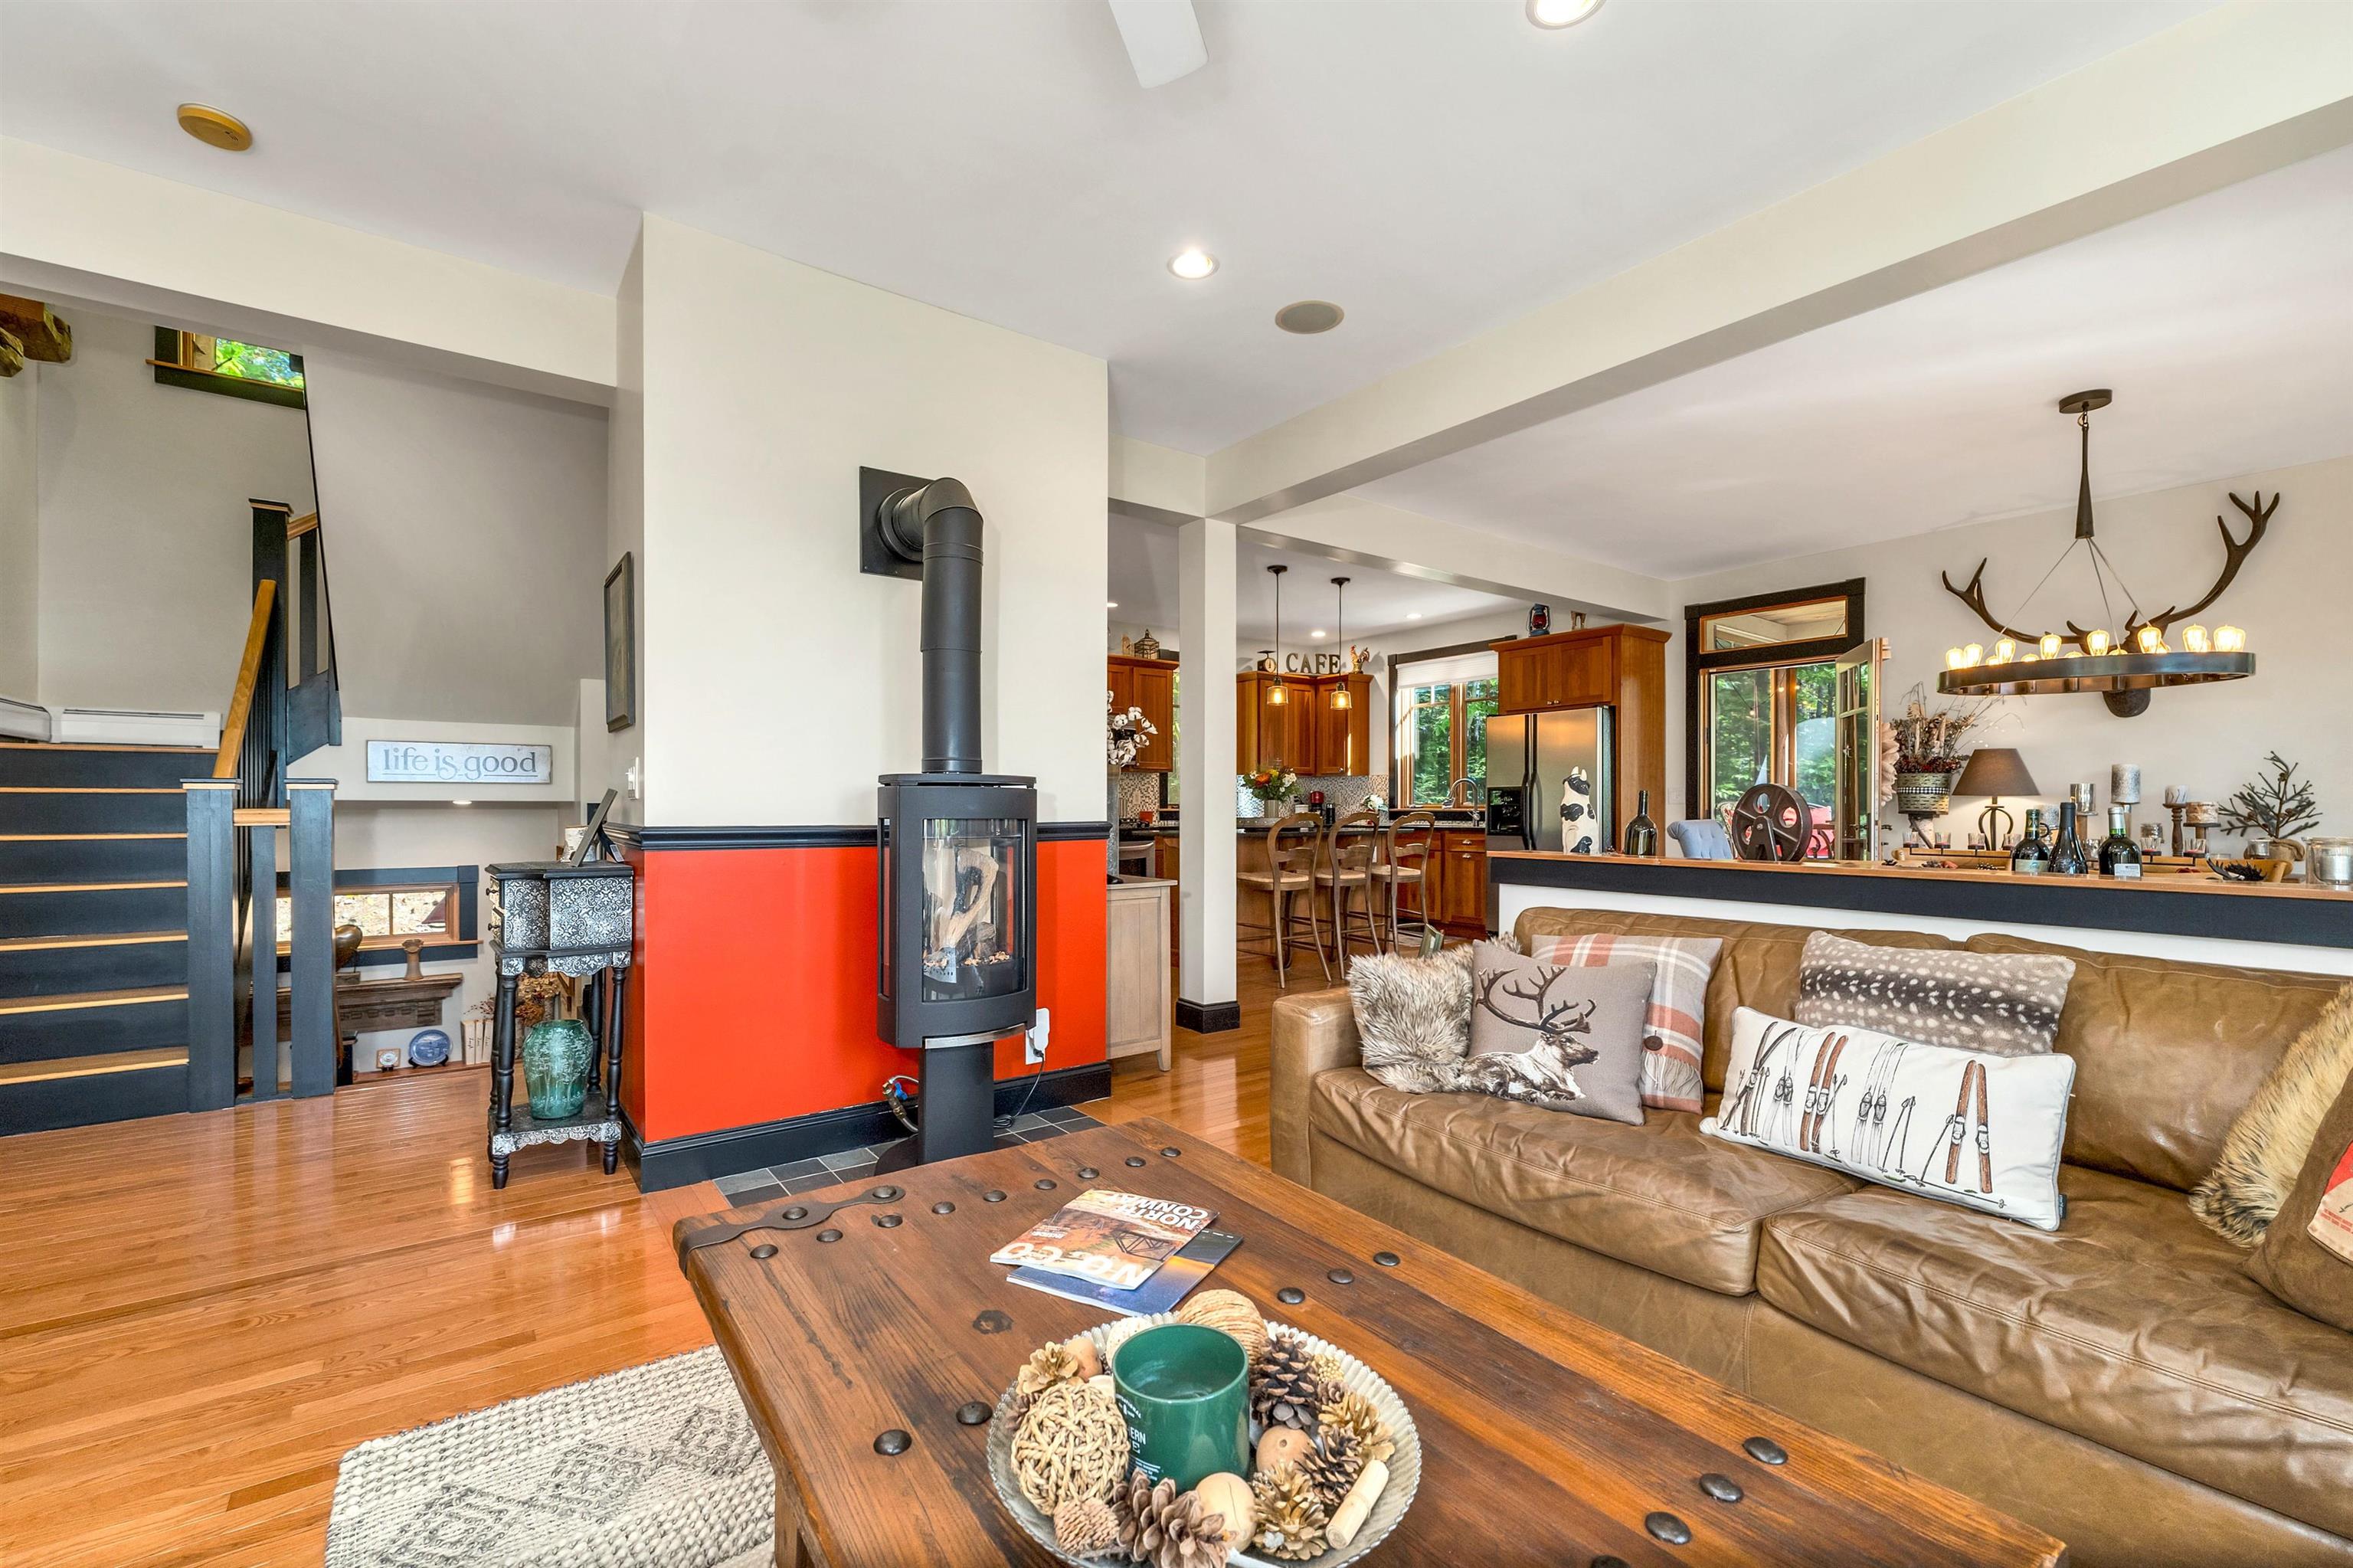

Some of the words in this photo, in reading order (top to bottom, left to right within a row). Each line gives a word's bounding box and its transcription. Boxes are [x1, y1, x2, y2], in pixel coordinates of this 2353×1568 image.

[1285, 653, 1341, 675] CAFE
[383, 747, 429, 771] life
[434, 748, 460, 780] is
[463, 751, 538, 780] good
[1128, 1426, 1147, 1445] ERN
